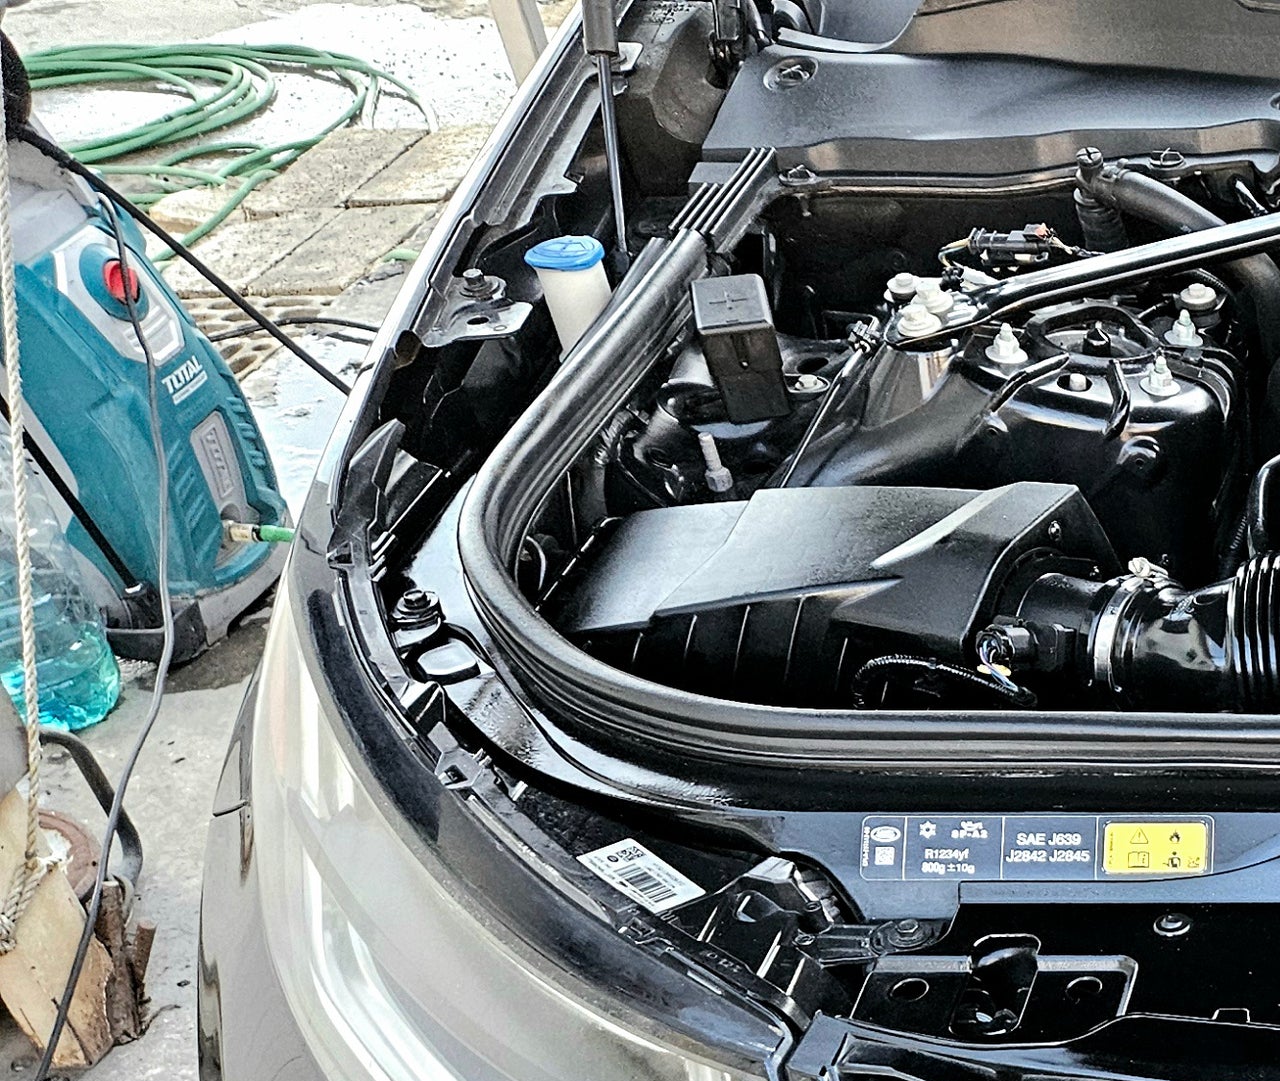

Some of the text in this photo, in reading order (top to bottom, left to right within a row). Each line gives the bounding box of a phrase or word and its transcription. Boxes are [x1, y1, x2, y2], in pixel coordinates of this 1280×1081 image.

[161, 355, 202, 394] TOTAL
[1016, 832, 1082, 846] SAE J639
[924, 848, 970, 862] R1234yf
[1005, 849, 1091, 862] J2842 J2845
